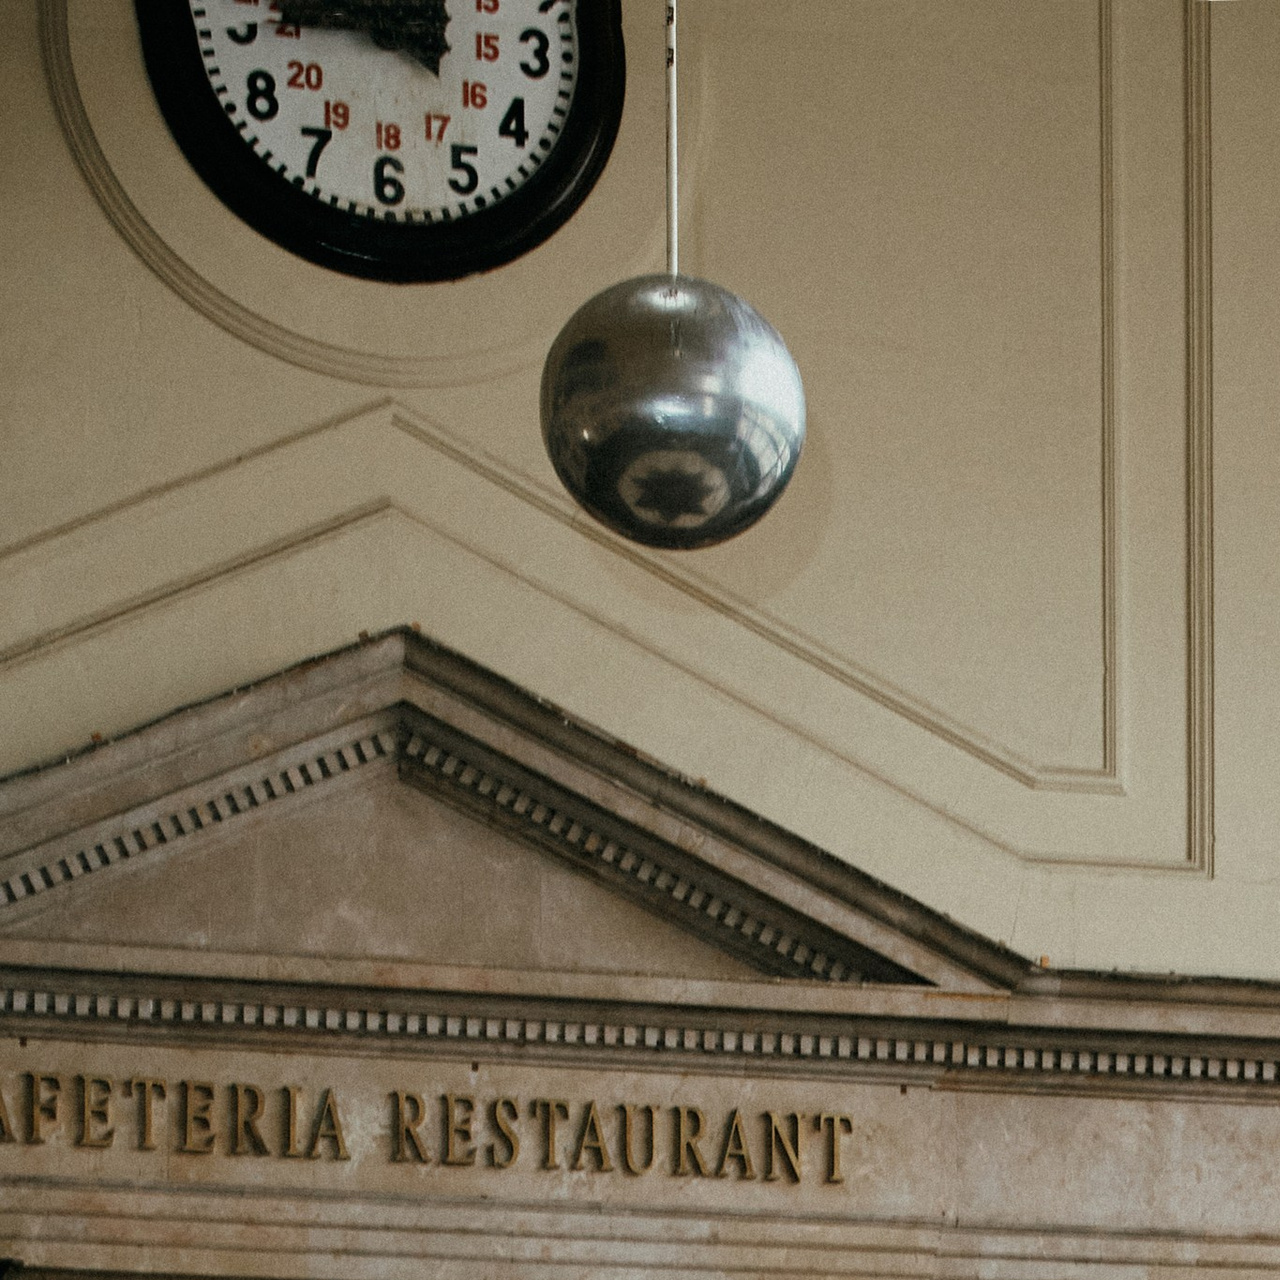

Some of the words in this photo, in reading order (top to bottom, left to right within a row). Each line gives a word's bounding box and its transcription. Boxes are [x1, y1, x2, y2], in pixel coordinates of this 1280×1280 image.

[475, 32, 500, 62] 15
[518, 27, 550, 80] 3
[246, 69, 279, 122] 8
[286, 60, 323, 91] 20
[461, 79, 488, 110] 16
[324, 100, 351, 131] 19
[376, 121, 402, 151] 18
[424, 112, 452, 144] 17
[498, 96, 530, 149] 4
[300, 126, 334, 179] 7
[447, 144, 479, 197] 5
[373, 155, 406, 207] 6
[387, 1089, 854, 1185] RESTAURANT
